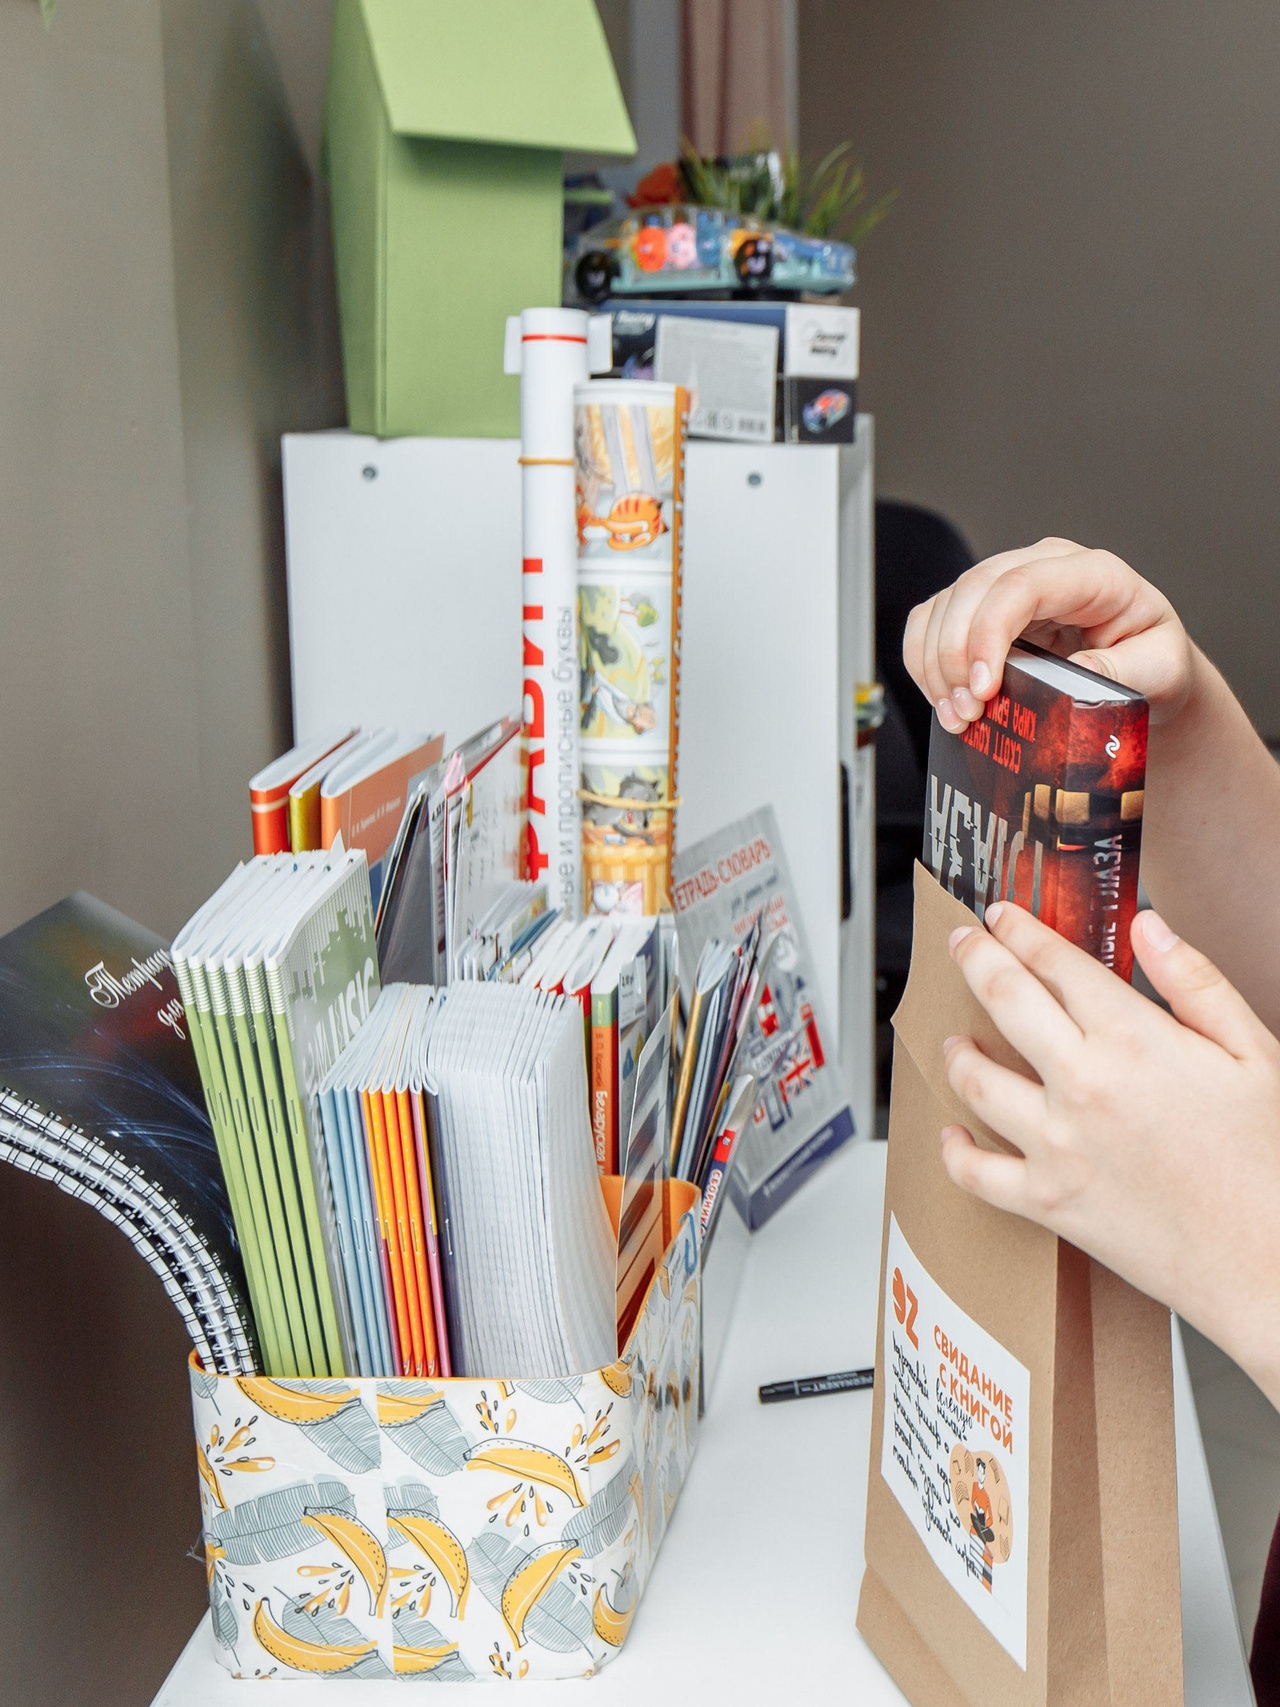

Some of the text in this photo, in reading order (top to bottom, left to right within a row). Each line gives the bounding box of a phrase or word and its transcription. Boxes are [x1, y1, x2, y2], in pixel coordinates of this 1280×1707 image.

[551, 606, 576, 683] буквы
[957, 720, 1022, 775] СКОТТ КОУТО
[1012, 701, 1037, 743] КИРА
[554, 689, 577, 833] прописные
[1089, 834, 1122, 911] ГЛАЗА
[84, 948, 175, 1010] Тетрад
[593, 1090, 608, 1162] Беларуская
[933, 1324, 1013, 1427] СВИДАНИЕ
[939, 1363, 1013, 1455] С КНИГОЙ
